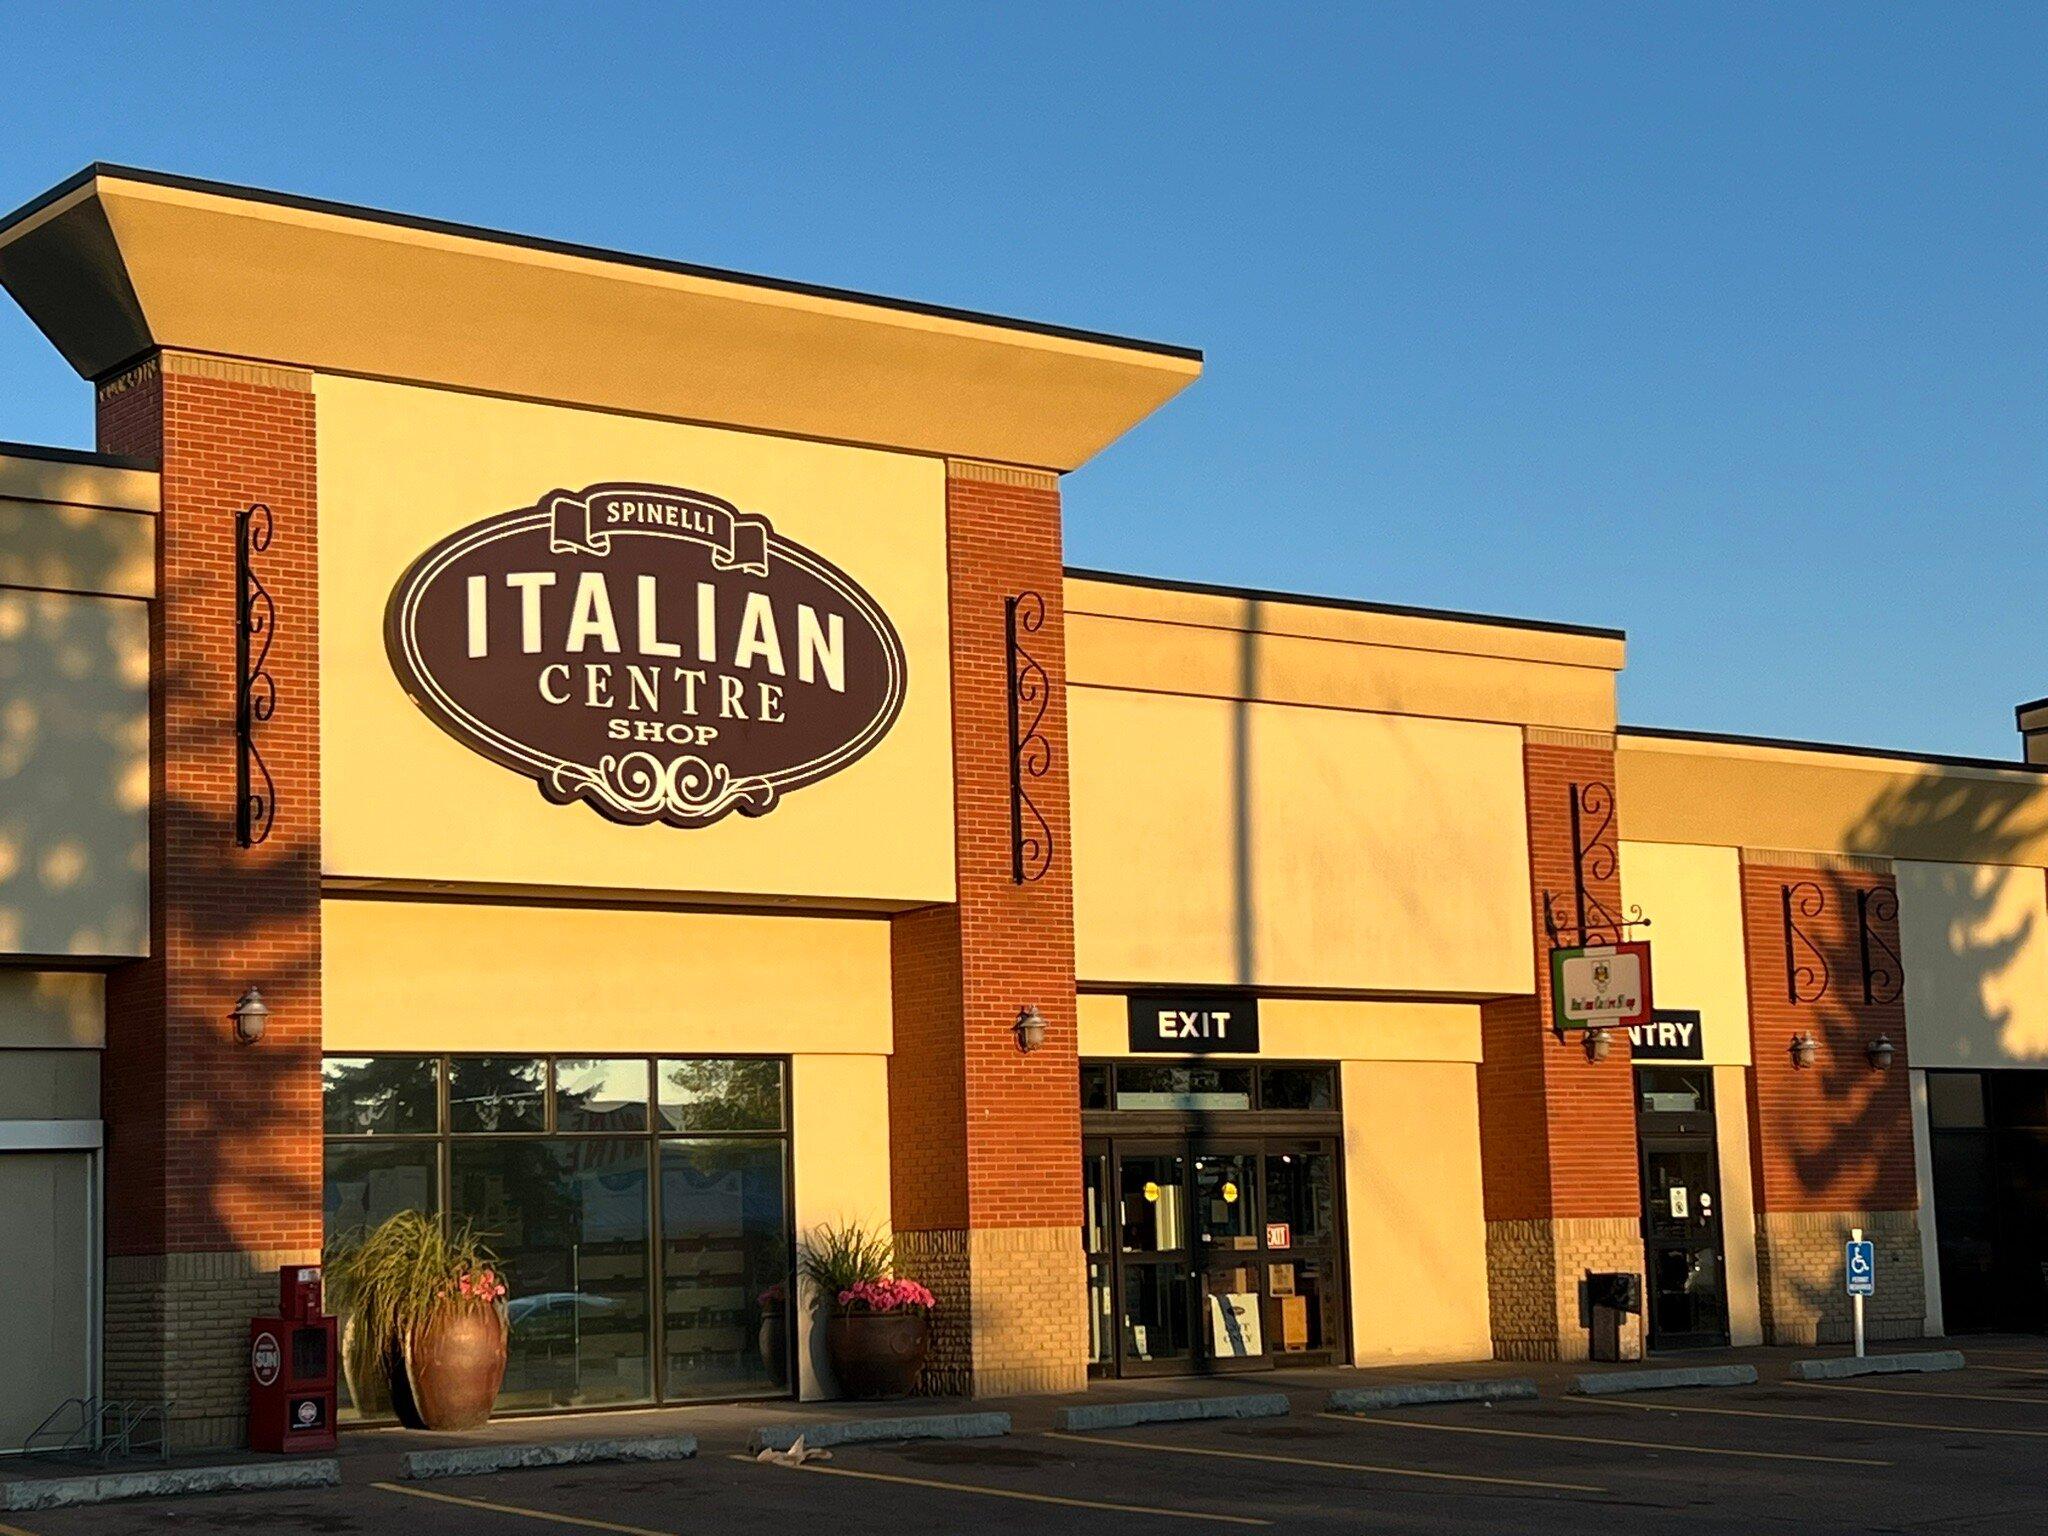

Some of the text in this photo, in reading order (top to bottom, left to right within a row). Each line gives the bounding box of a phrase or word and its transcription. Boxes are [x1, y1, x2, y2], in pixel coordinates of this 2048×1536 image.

[606, 501, 714, 535] SPINELLI
[467, 571, 846, 693] ITALIAN
[538, 664, 786, 723] CENTRE
[608, 718, 719, 746] SHOP
[1158, 1010, 1231, 1038] EXIT
[1628, 1022, 1694, 1047] NTRY
